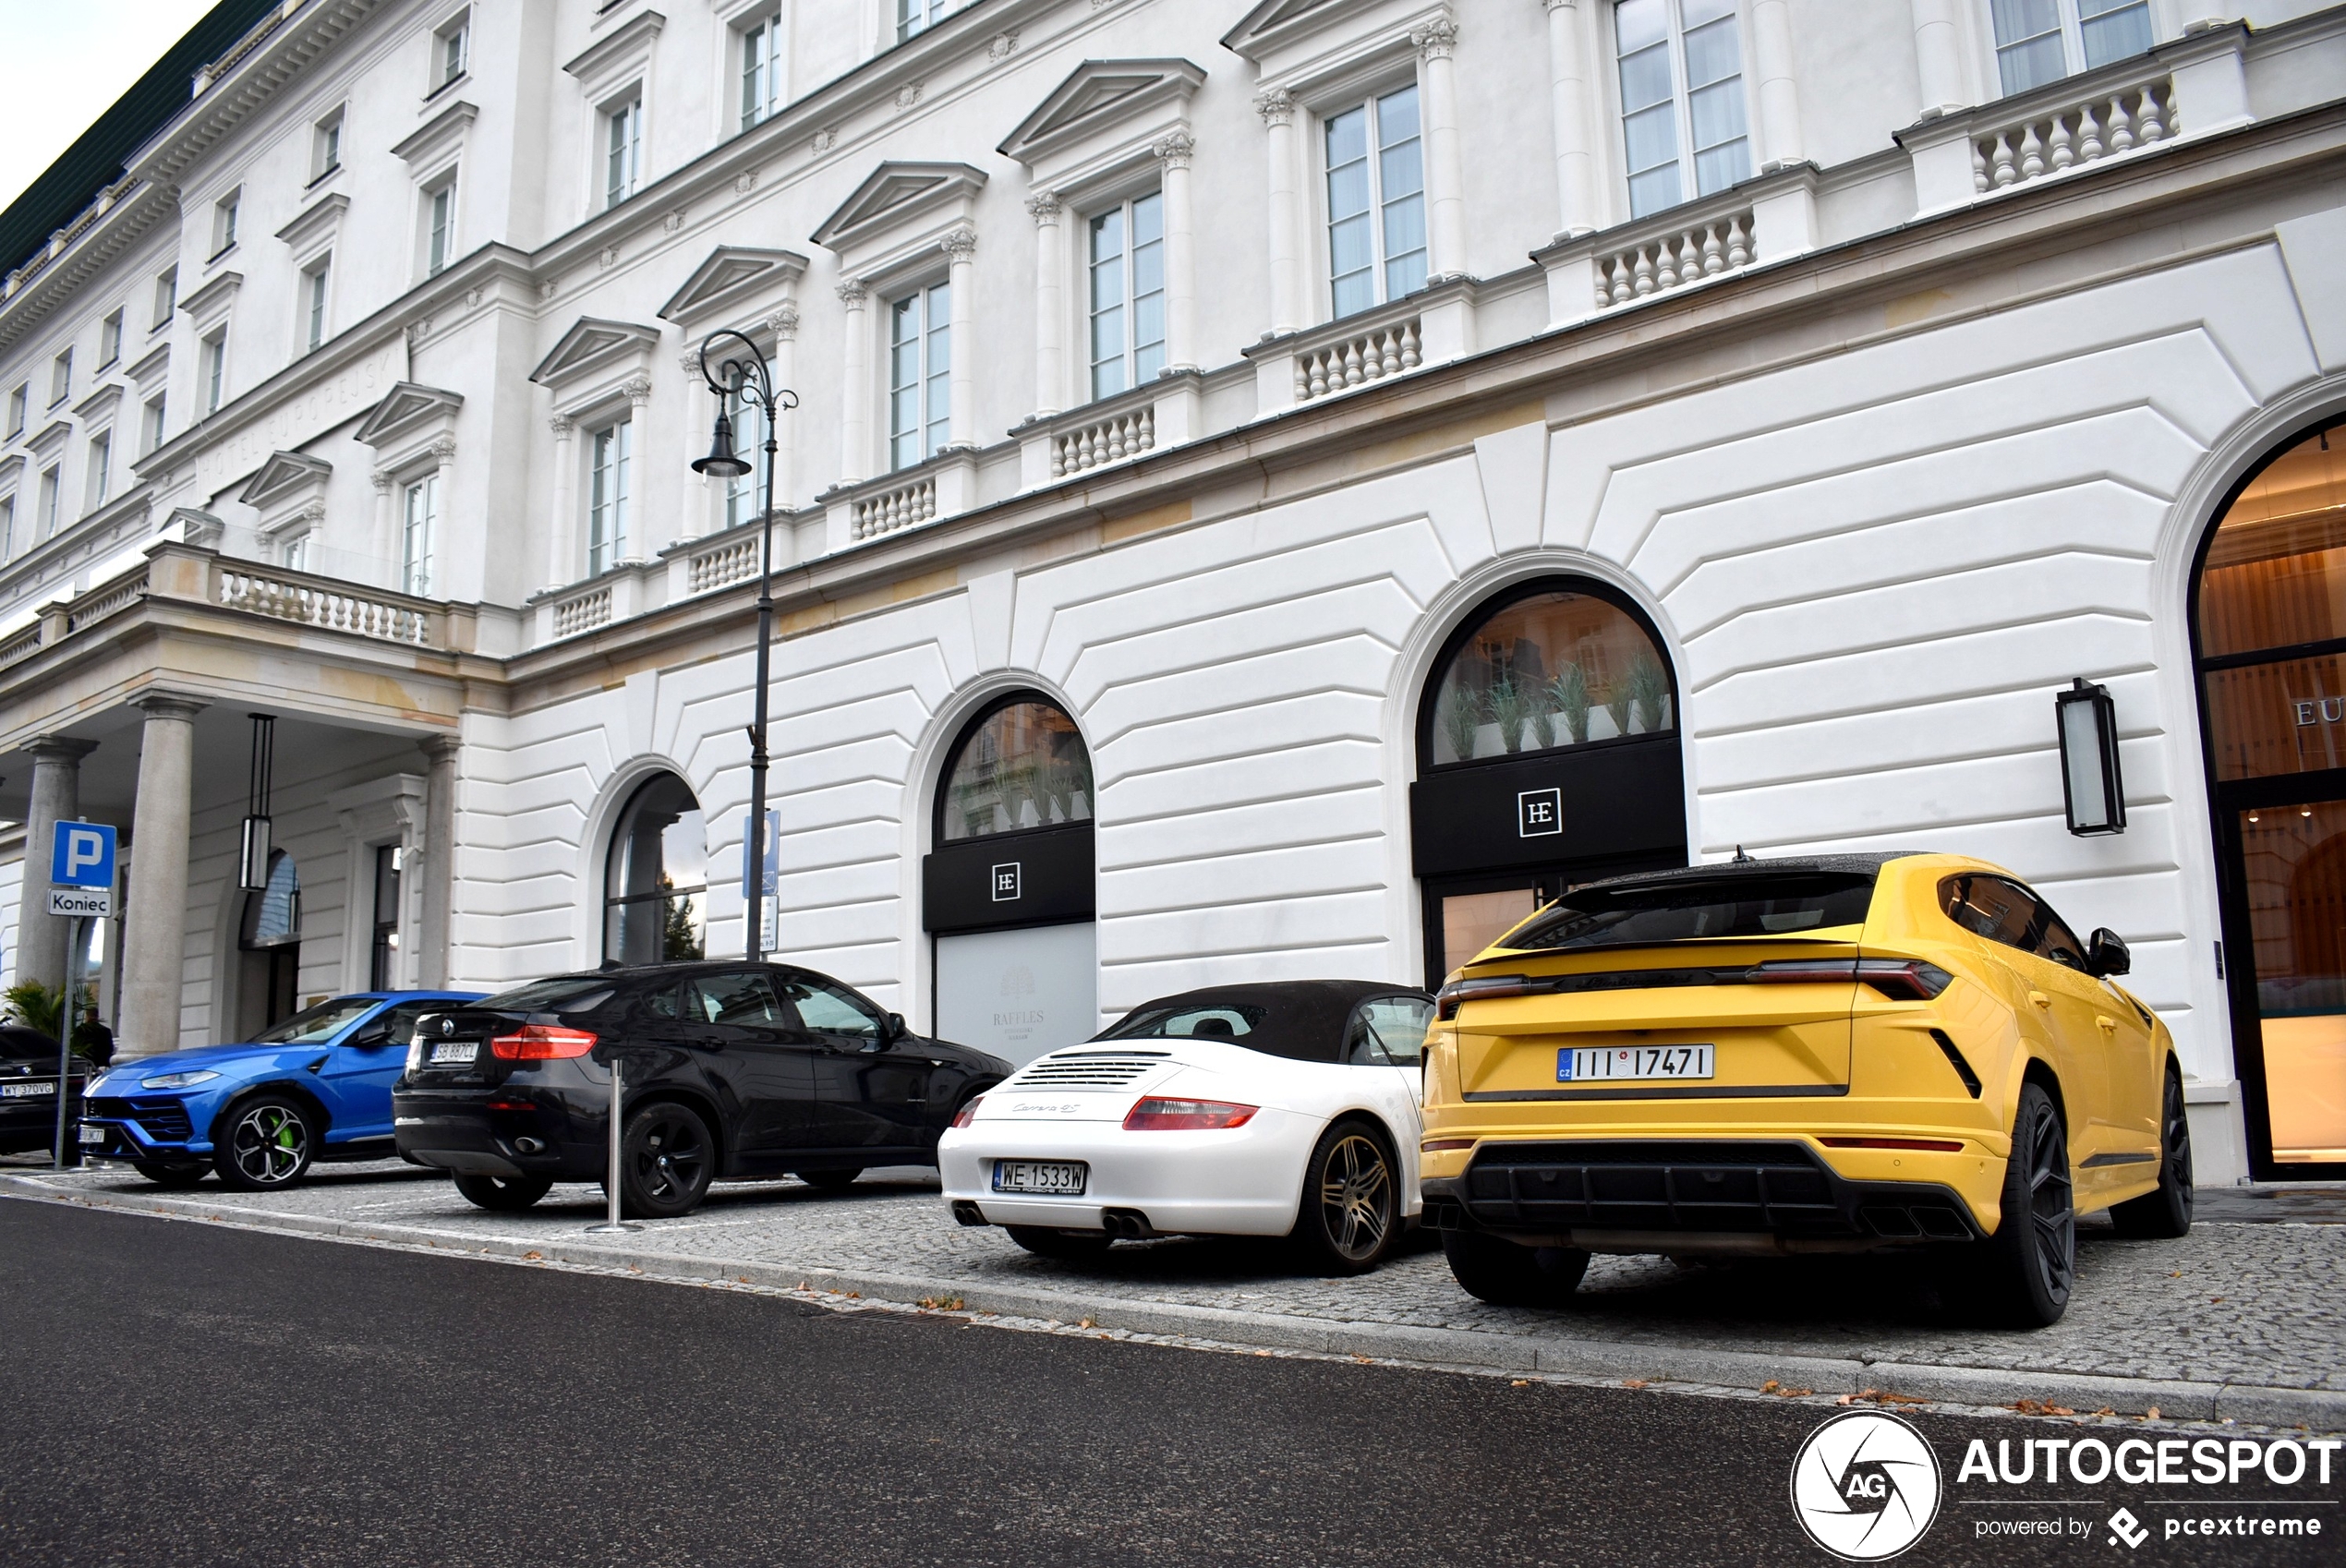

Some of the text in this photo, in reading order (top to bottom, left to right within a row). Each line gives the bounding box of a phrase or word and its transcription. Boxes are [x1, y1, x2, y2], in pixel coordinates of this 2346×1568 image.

[2293, 697, 2343, 726] EU
[1528, 802, 1553, 824] HE
[67, 829, 103, 877] P
[53, 894, 107, 912] Koniec
[993, 1009, 1045, 1026] RAFFLES
[437, 1045, 448, 1058] SB
[1559, 1068, 1571, 1077] CZ
[5, 1085, 18, 1095] WY
[1003, 1164, 1082, 1188] WE 1533W
